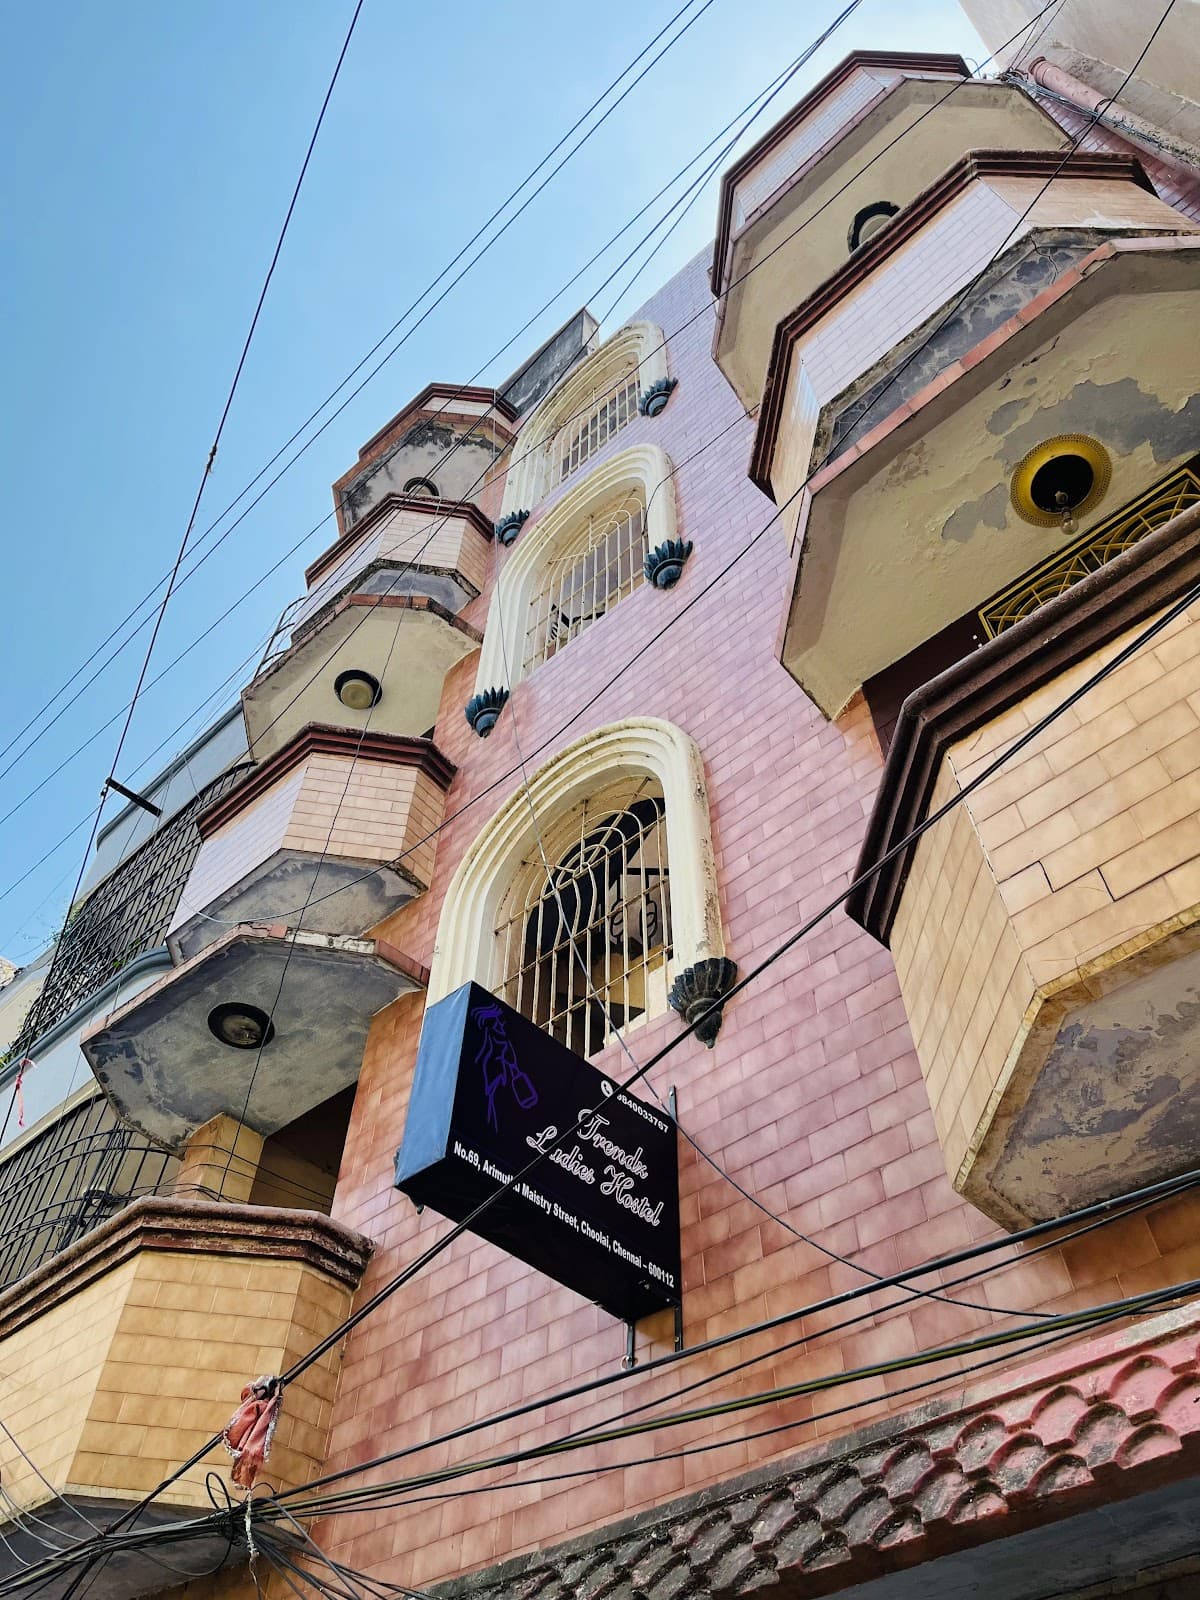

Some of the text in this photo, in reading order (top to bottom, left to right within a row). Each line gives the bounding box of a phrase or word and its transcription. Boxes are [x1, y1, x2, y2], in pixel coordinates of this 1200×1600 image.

[453, 1140, 481, 1172] No.69,
[521, 1182, 552, 1215] Maistry
[552, 1202, 580, 1233] Street,
[580, 1220, 612, 1253] Choolai,
[612, 1240, 642, 1269] Chennai
[648, 1261, 675, 1289] 600112
[600, 1164, 664, 1227] Hostel
